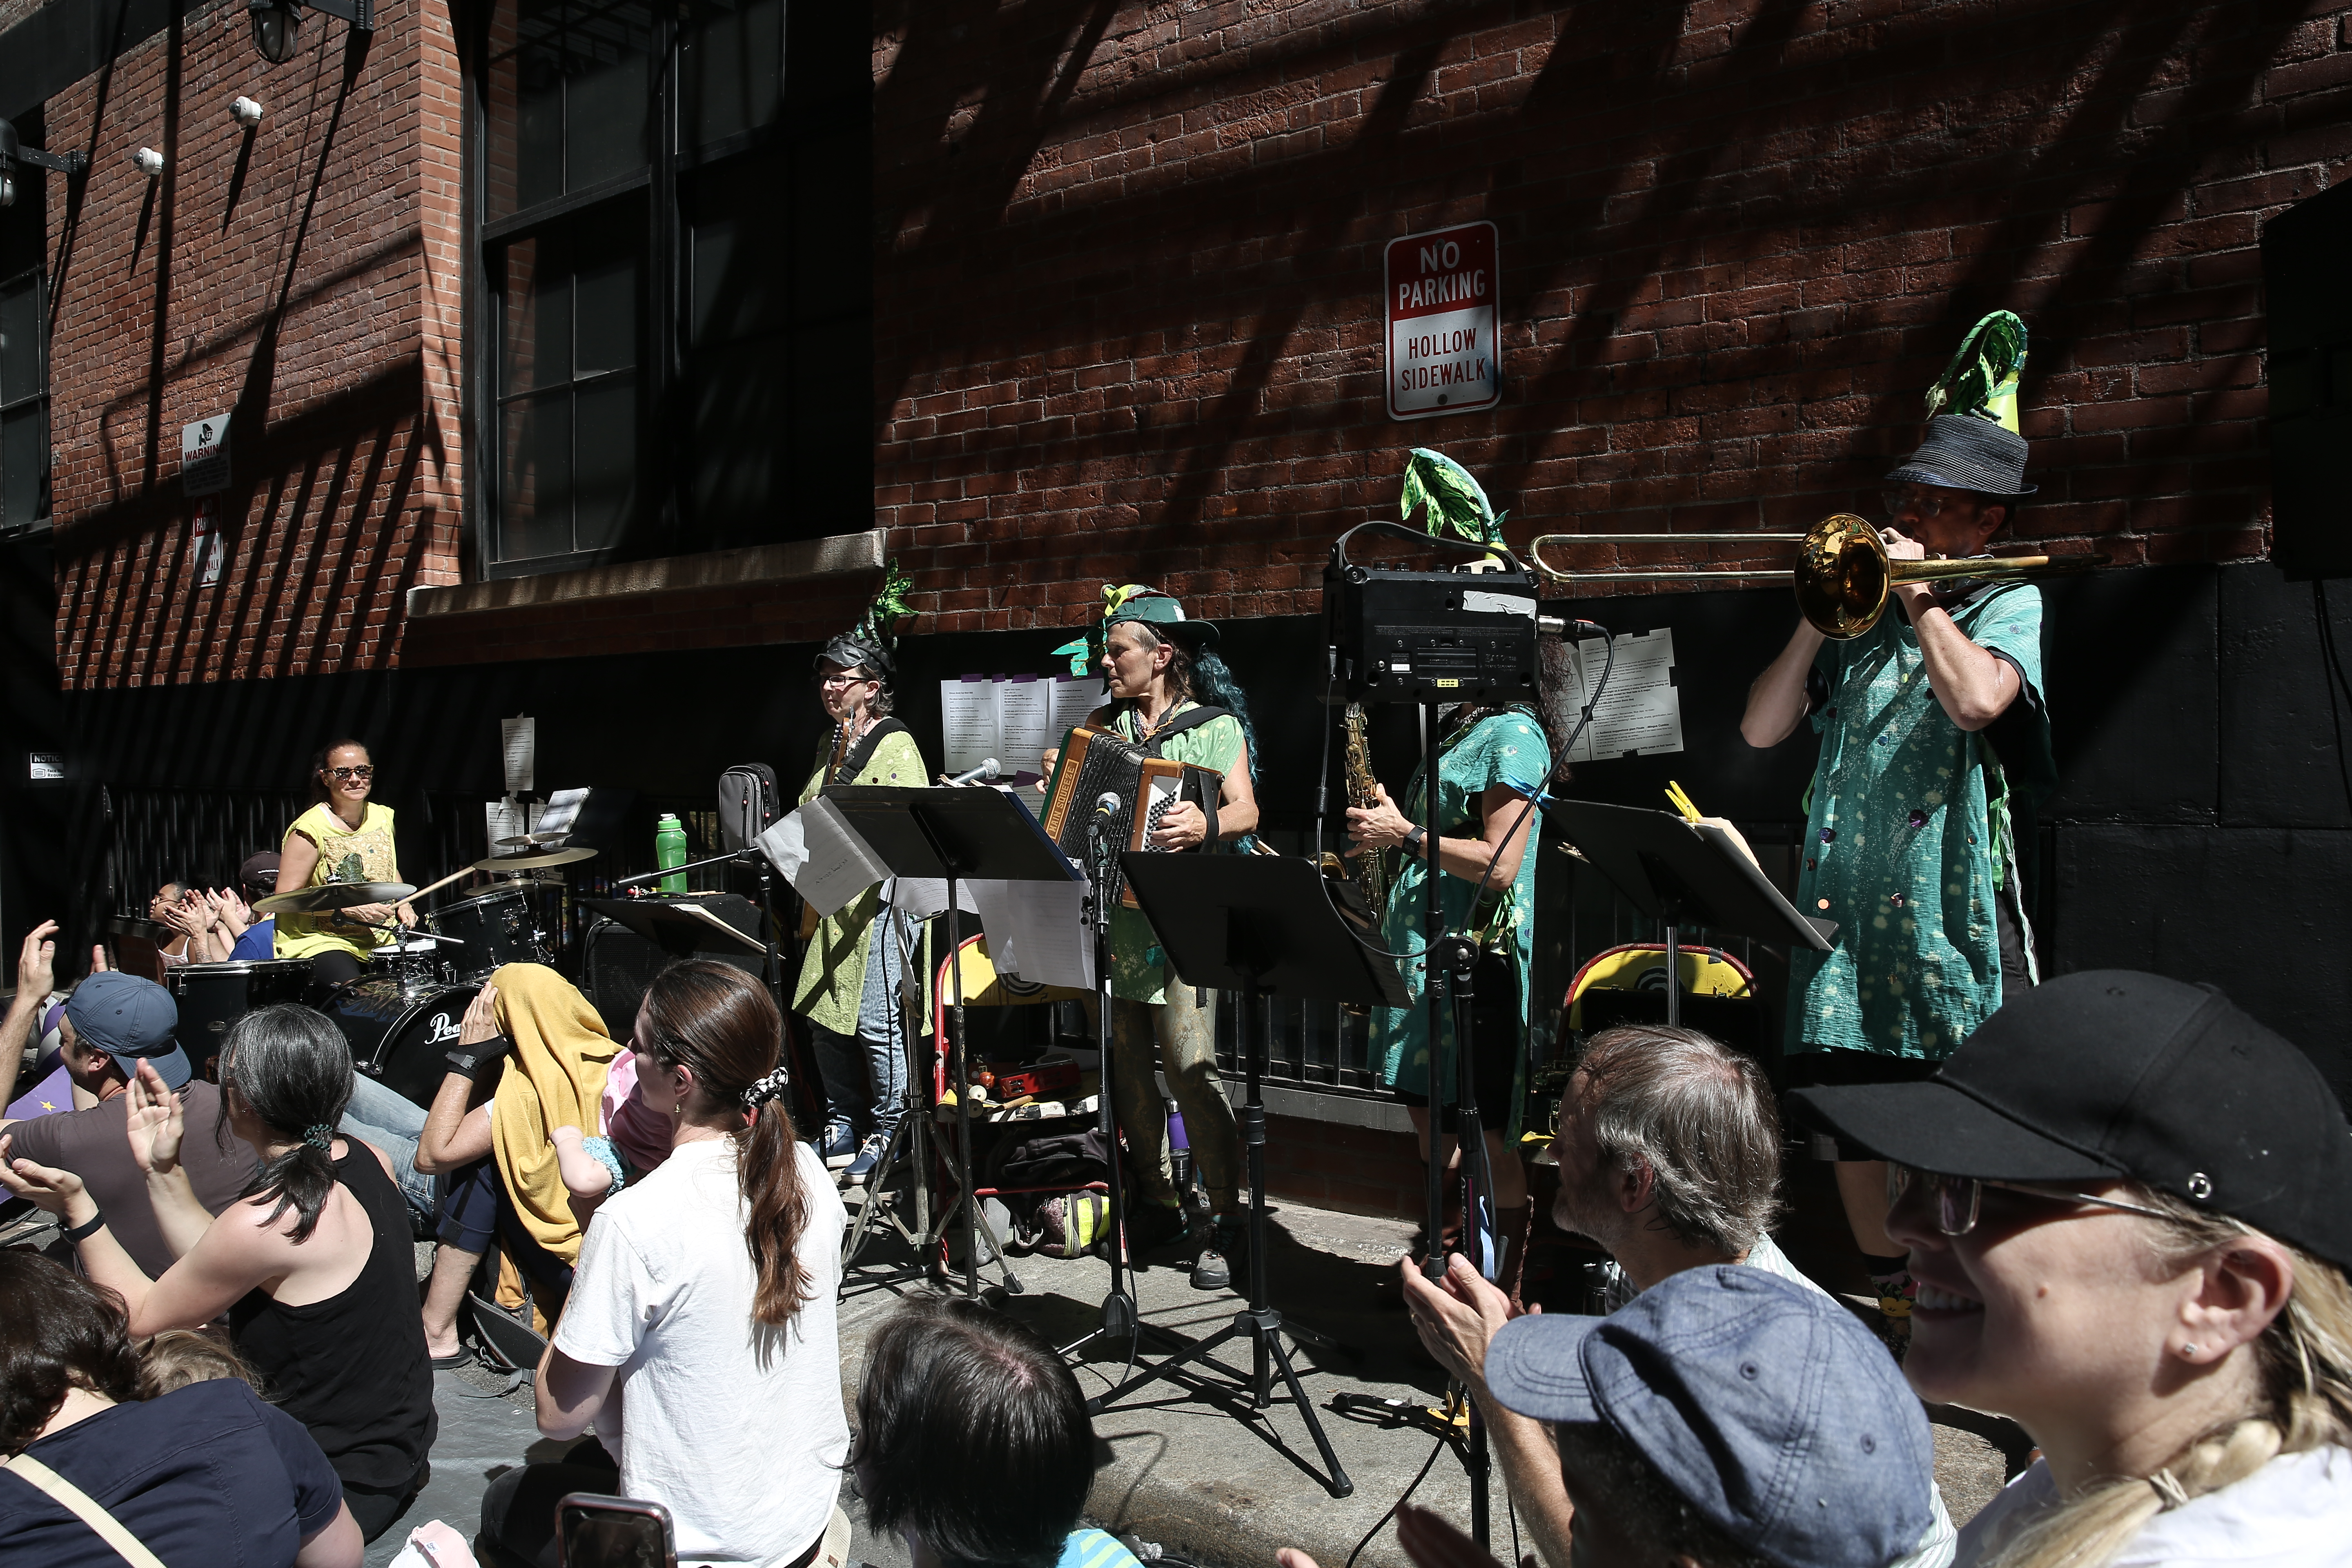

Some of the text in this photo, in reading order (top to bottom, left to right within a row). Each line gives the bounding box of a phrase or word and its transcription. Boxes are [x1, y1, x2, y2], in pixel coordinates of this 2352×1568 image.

[1421, 242, 1459, 273] NO
[1399, 270, 1485, 310] PARKING
[1409, 328, 1476, 359] HOLLOW
[1401, 358, 1486, 391] SIDEWALK
[185, 442, 228, 461] WARNING!
[202, 499, 212, 514] NO
[197, 514, 218, 532] PARKING
[200, 543, 217, 557] HOLLOW
[198, 559, 219, 573] SIDEWALK
[1049, 766, 1075, 832] MAIN SQUEEZE
[424, 1013, 462, 1044] Pea
